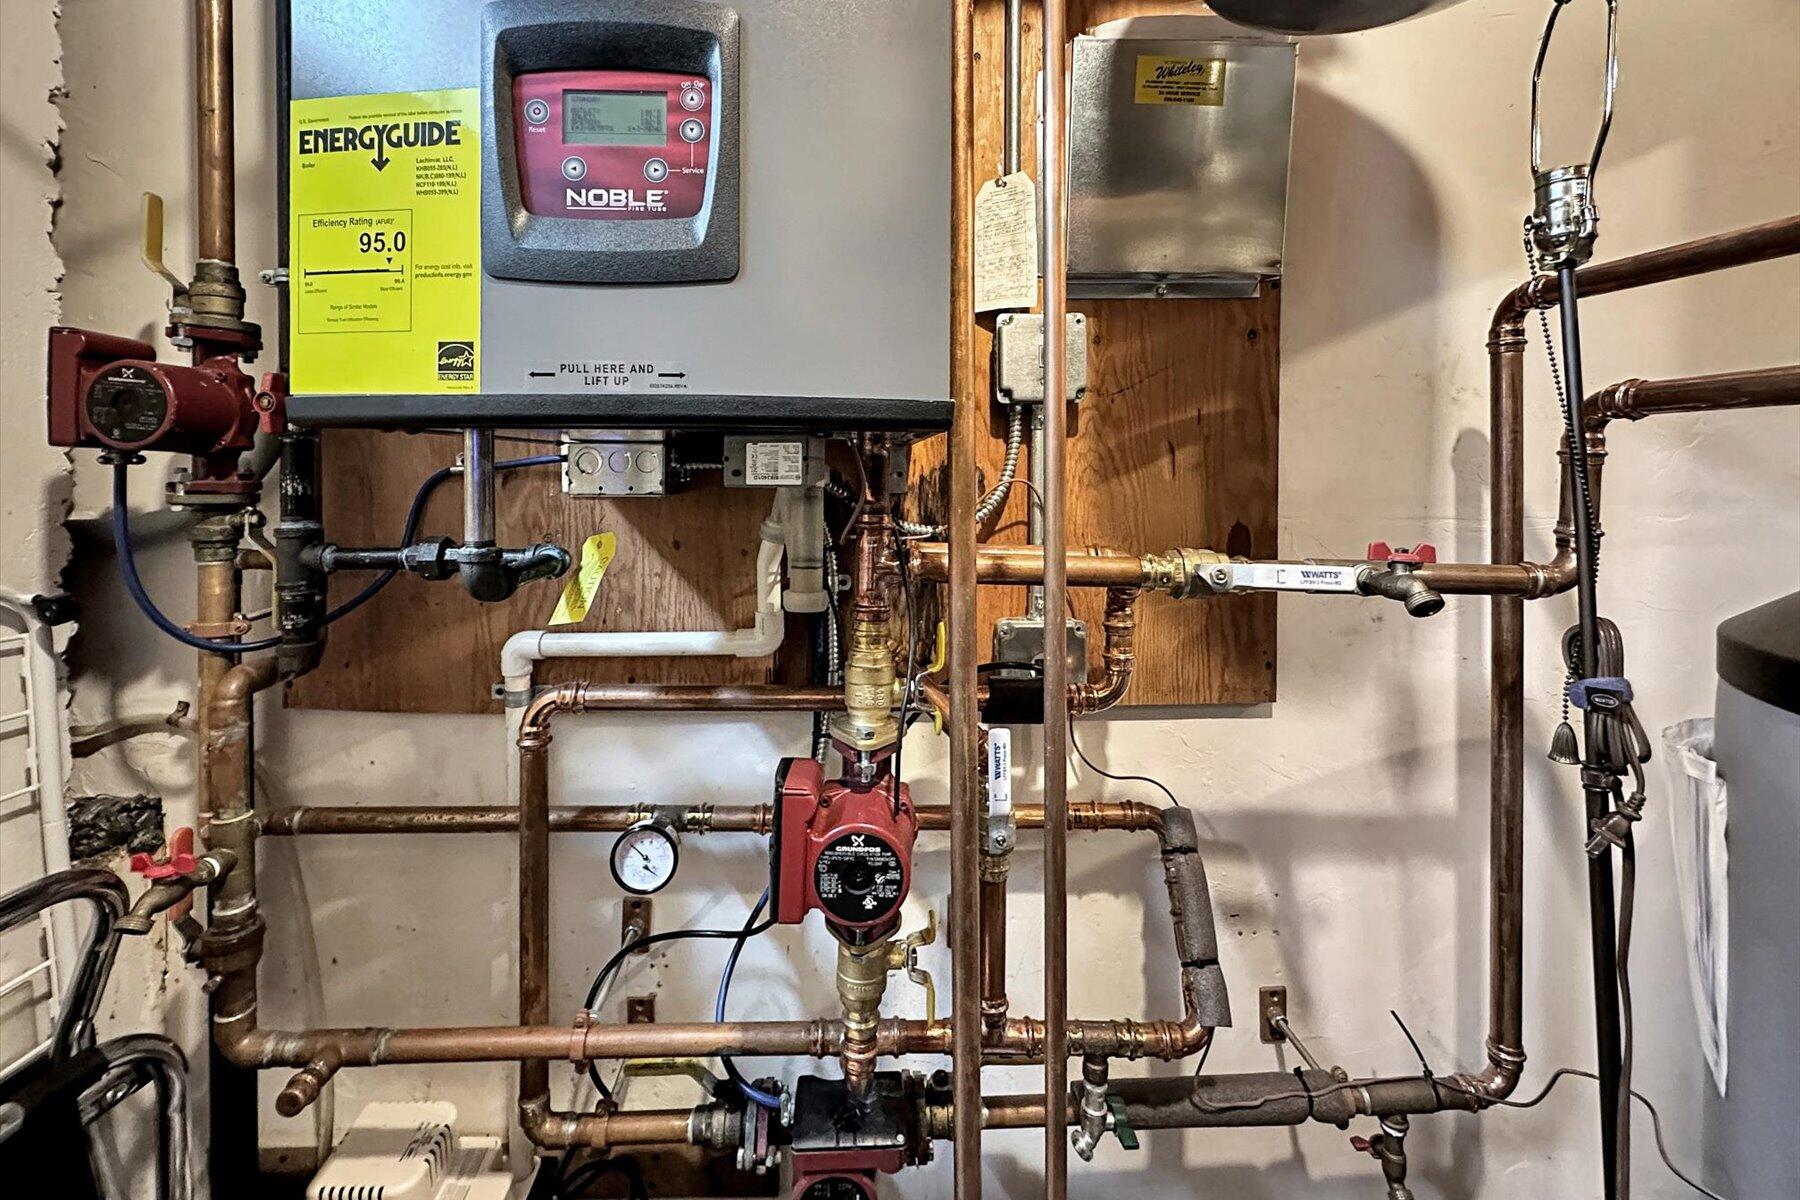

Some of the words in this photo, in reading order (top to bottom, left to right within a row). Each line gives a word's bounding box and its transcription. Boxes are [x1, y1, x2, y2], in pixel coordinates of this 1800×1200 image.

[681, 81, 691, 89] On
[693, 80, 704, 89] Off
[528, 126, 546, 134] Reset
[299, 121, 461, 155] ENERGYGUIDE
[566, 188, 665, 207] NOBLE
[312, 218, 348, 228] Efficiency
[349, 217, 373, 227] Rating
[359, 231, 406, 253] 95.0
[560, 364, 590, 374] PULL
[594, 364, 625, 374] HERE
[629, 364, 654, 374] AND
[584, 376, 609, 386] LIFT
[614, 376, 630, 386] UP
[1302, 570, 1340, 579] WATTS
